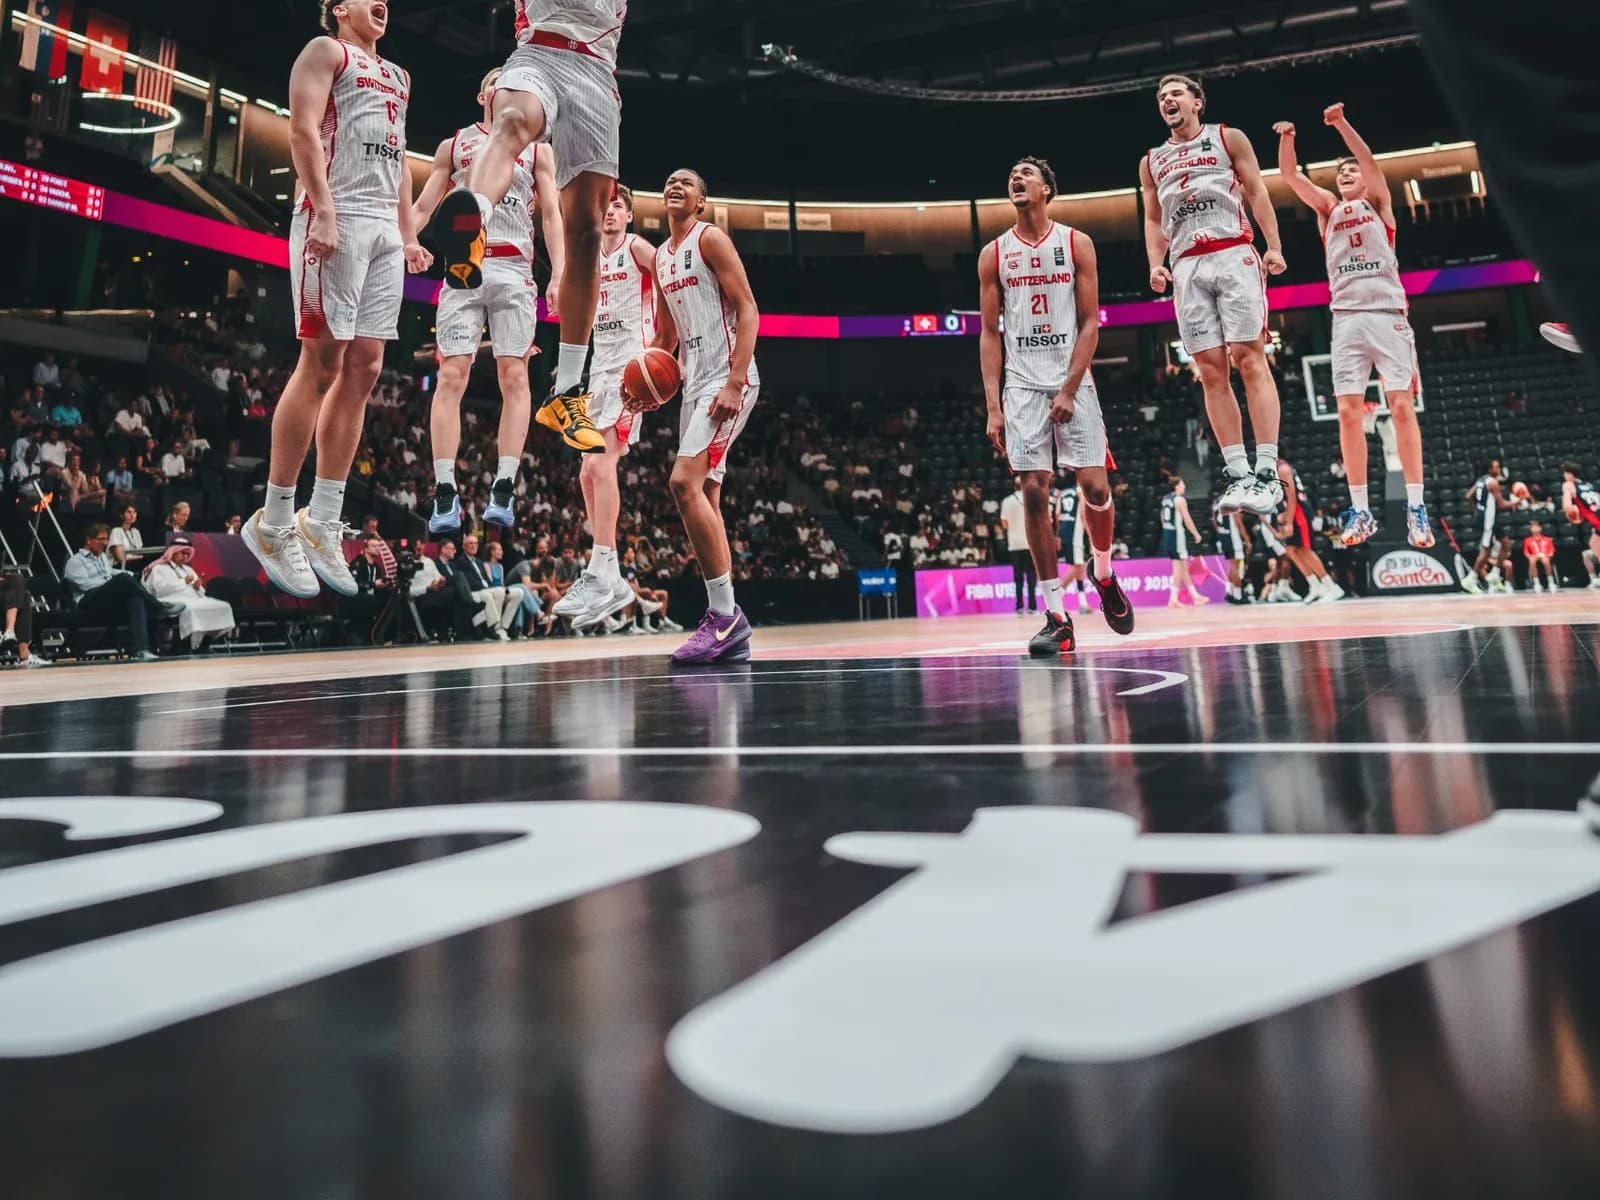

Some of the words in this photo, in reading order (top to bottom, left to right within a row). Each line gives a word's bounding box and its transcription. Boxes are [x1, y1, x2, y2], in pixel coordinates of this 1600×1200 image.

[362, 141, 402, 162] TISSO
[1180, 173, 1191, 190] 2
[1348, 232, 1363, 249] 13
[1337, 261, 1381, 274] TISSOT
[1007, 273, 1071, 288] SWITZERLAND
[1030, 293, 1049, 315] 21
[1016, 334, 1068, 347] TISSOT
